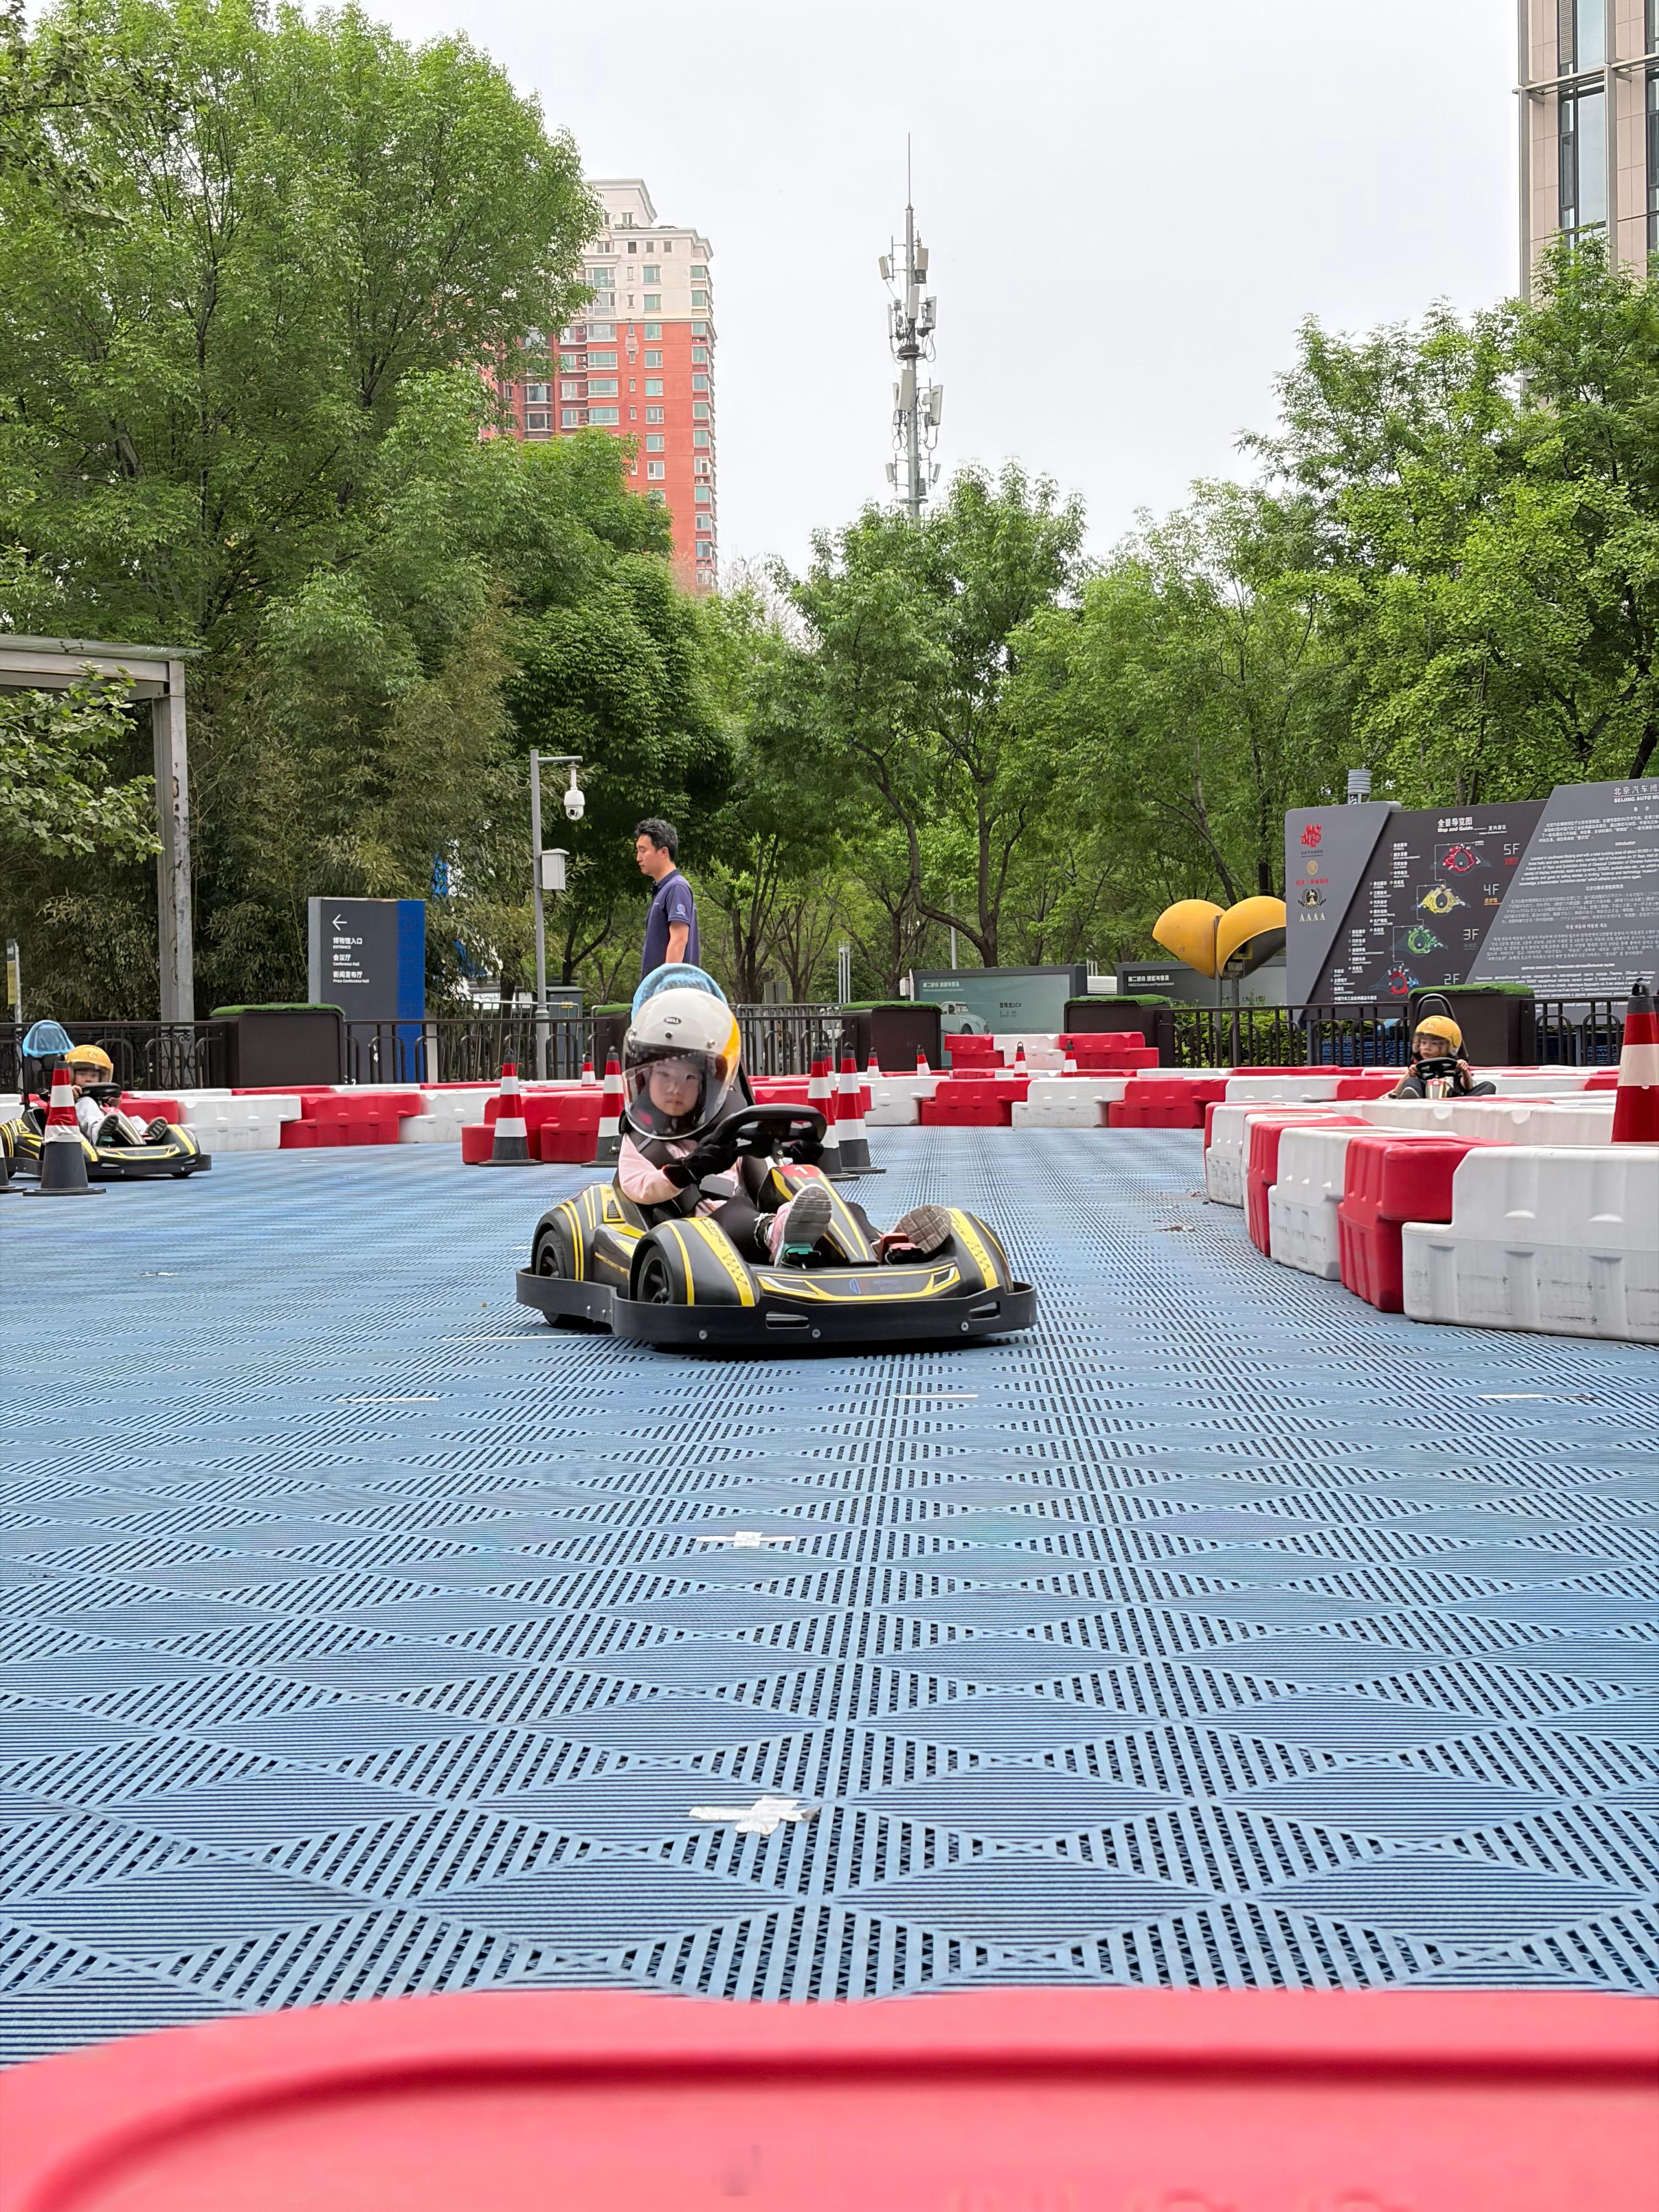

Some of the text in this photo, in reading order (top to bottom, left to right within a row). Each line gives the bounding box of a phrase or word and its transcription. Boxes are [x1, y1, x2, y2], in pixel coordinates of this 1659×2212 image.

[1437, 817, 1472, 828] 全景导览图
[1504, 843, 1520, 855] 5F
[1483, 884, 1500, 895] 4F
[1463, 929, 1480, 940] 3F
[1444, 973, 1460, 985] 2F
